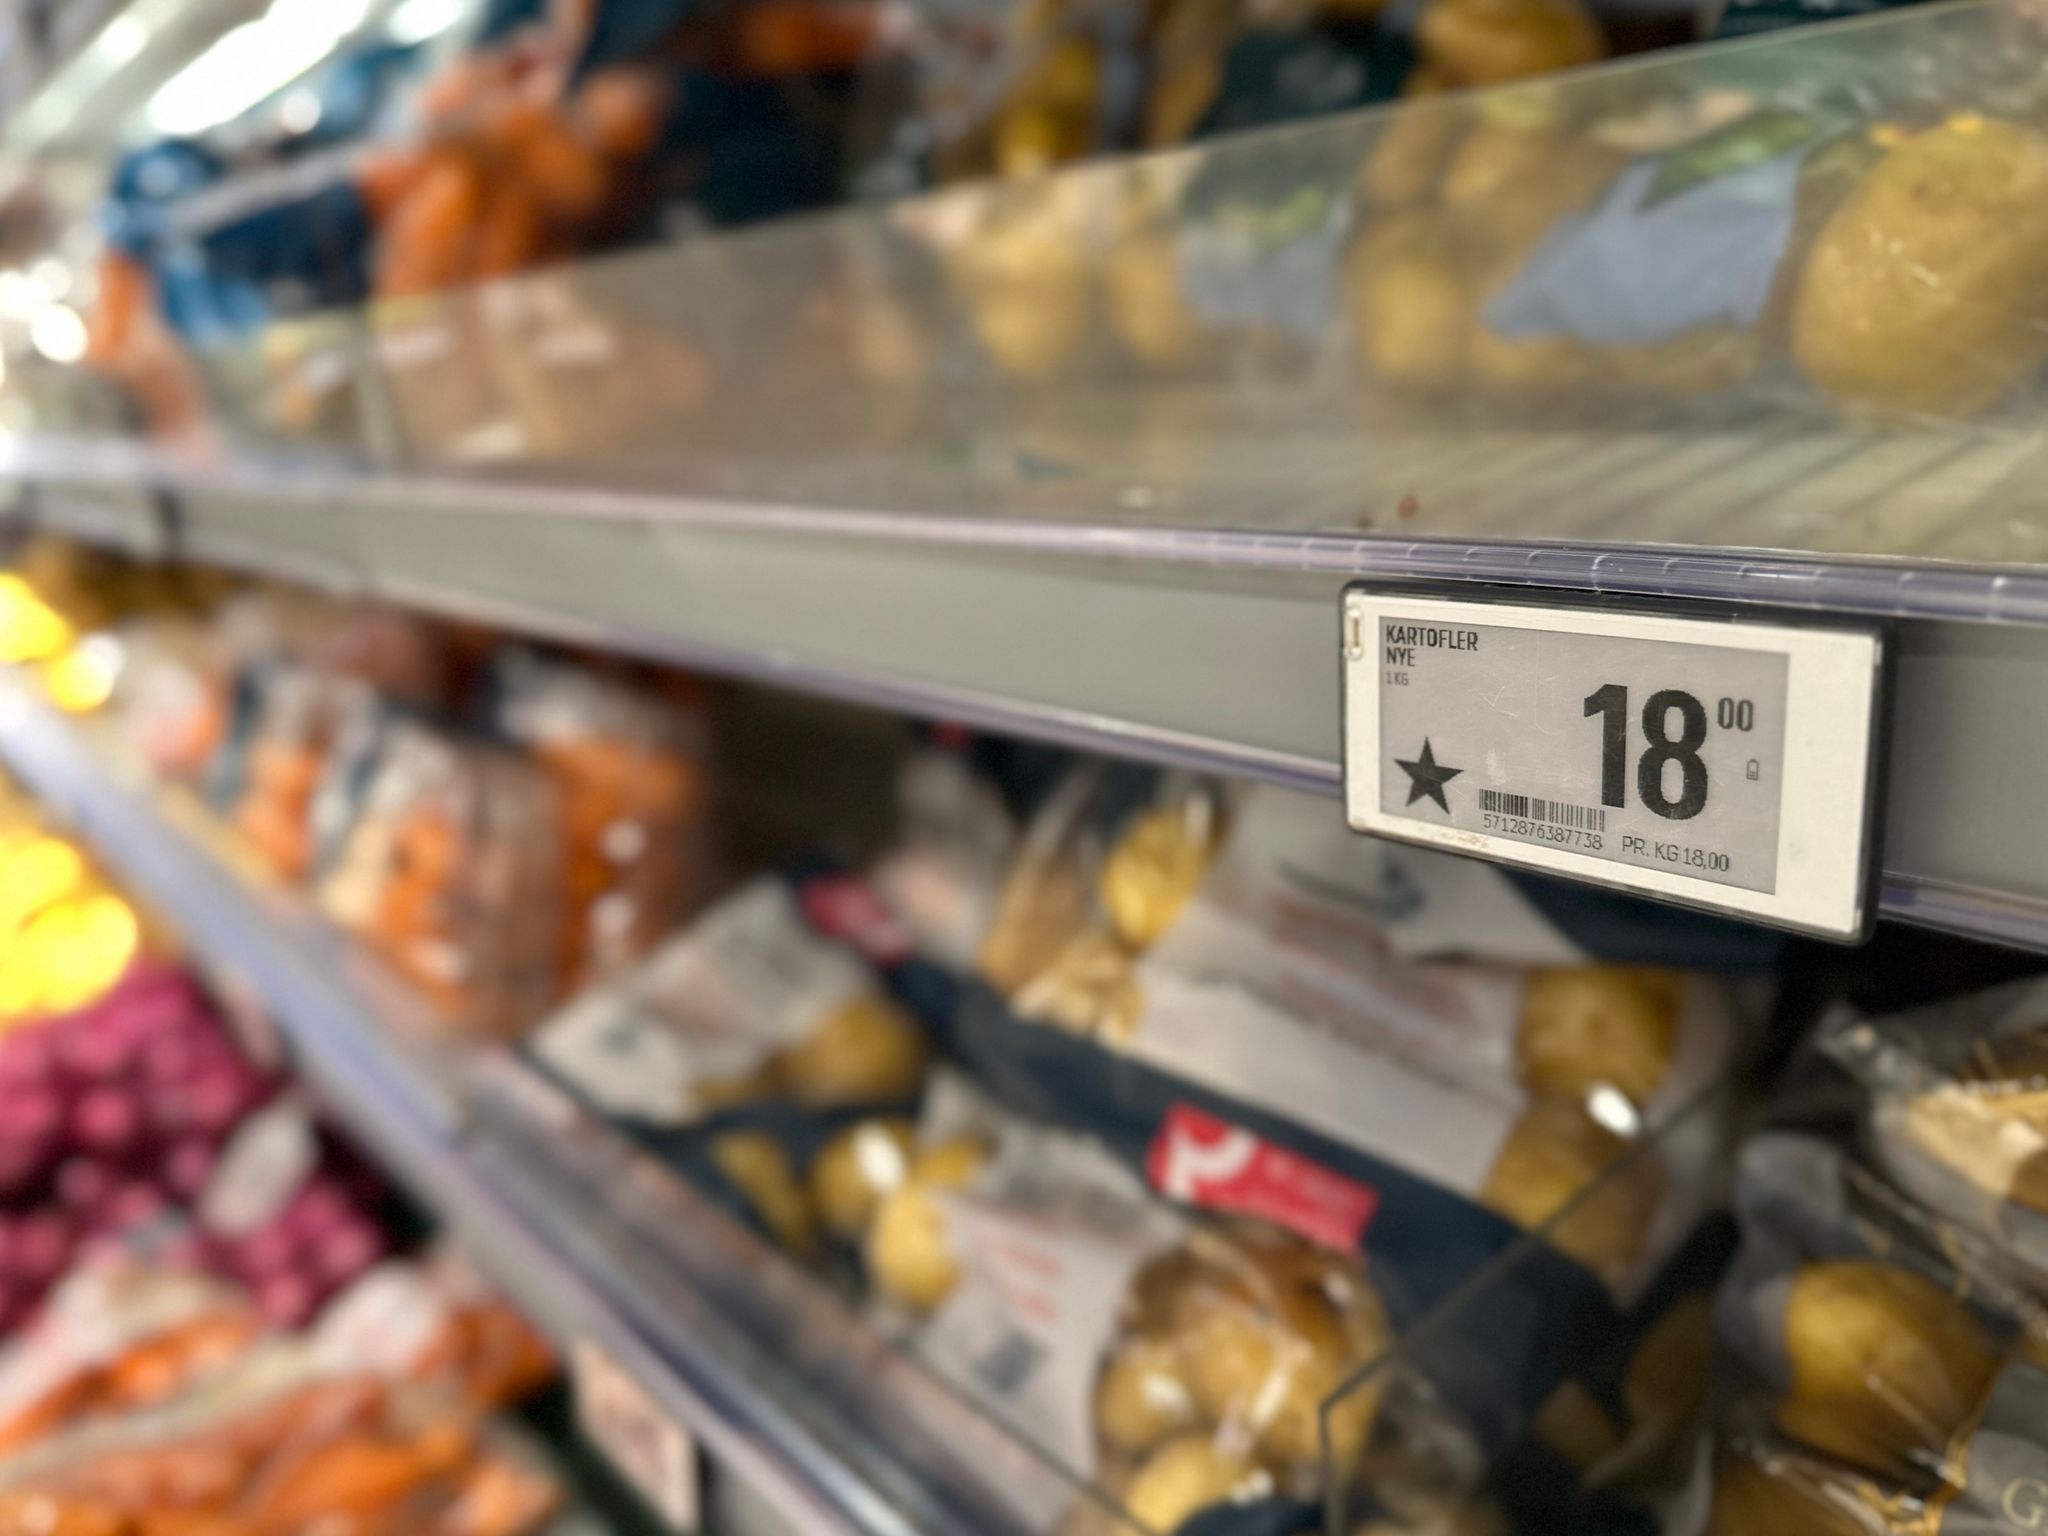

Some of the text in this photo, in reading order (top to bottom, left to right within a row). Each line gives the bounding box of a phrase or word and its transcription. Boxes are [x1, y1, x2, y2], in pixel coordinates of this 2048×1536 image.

[1386, 625, 1478, 651] KARTOFLER
[1386, 646, 1416, 667] NYE
[1584, 684, 1754, 820] 18 00
[1483, 814, 1603, 850] 5712876387738
[1622, 836, 1730, 871] PR. KG 18,00
